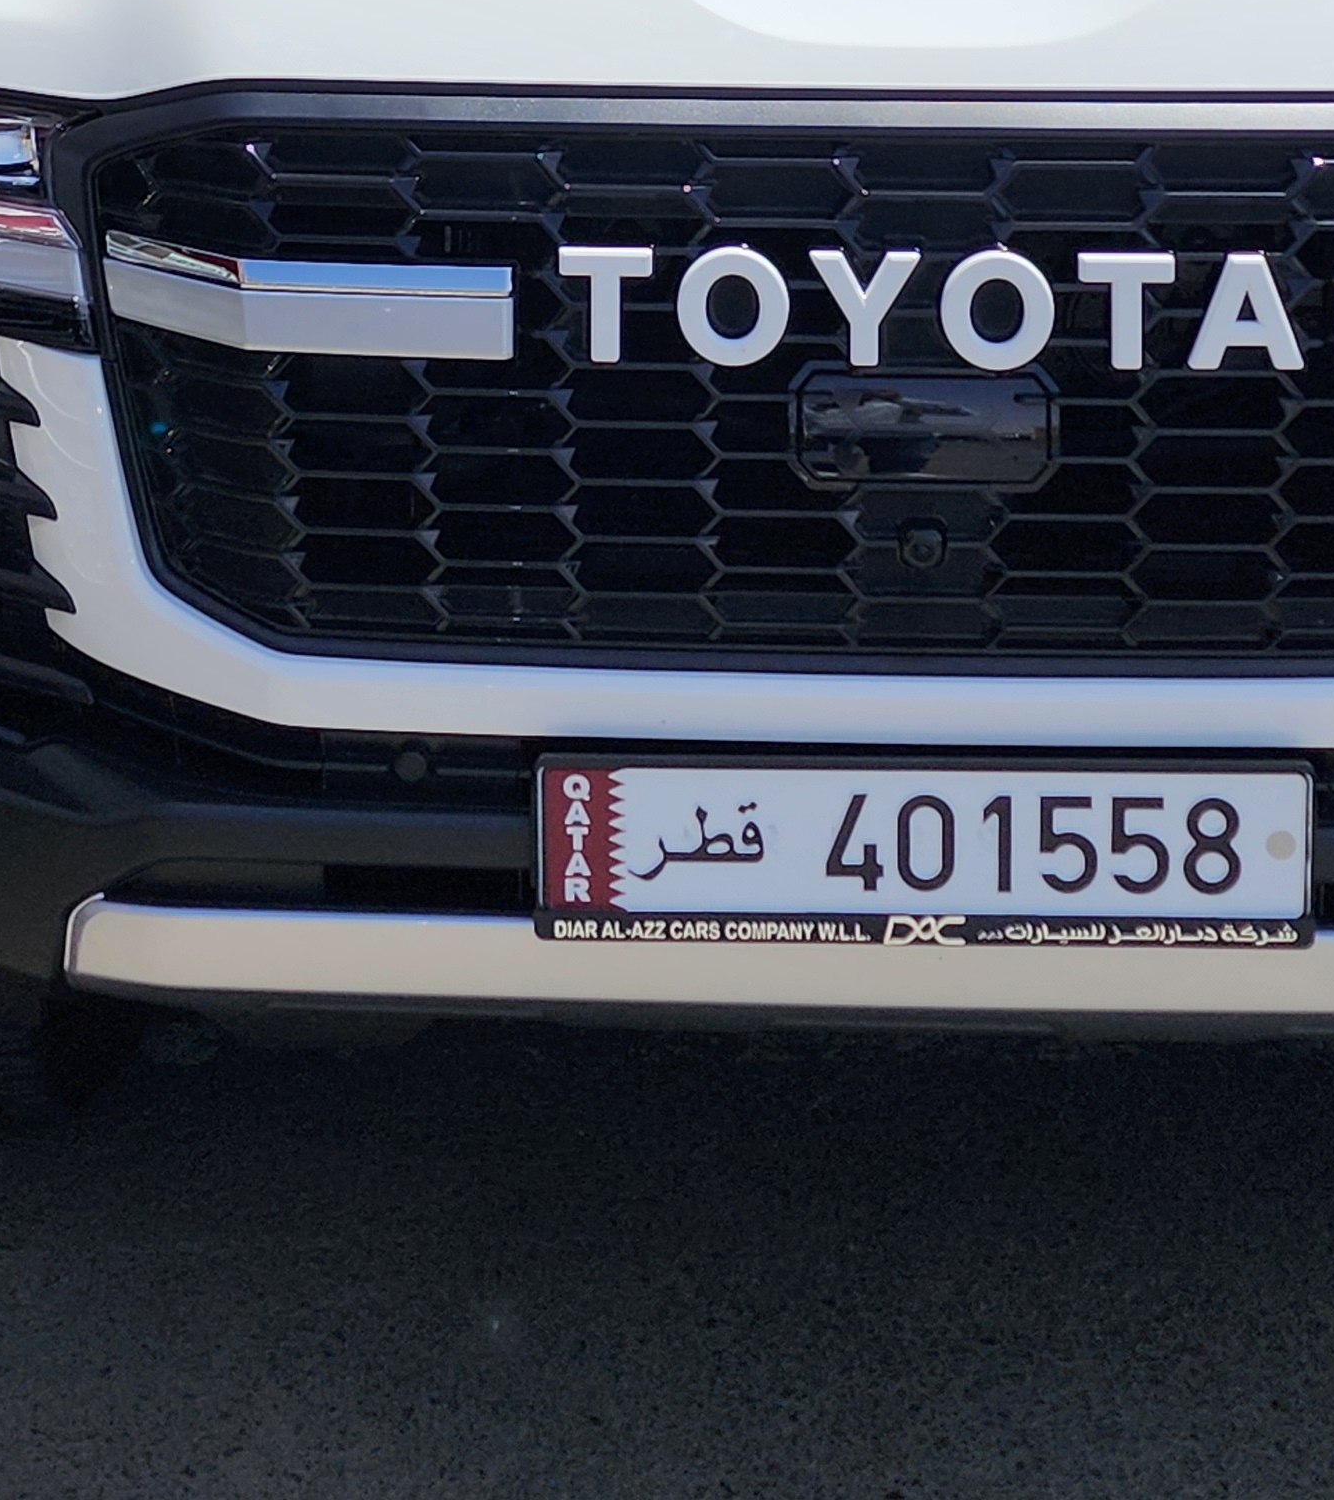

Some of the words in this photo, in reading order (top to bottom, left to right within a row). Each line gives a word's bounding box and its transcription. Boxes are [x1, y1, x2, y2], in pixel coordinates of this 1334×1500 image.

[558, 244, 1305, 371] TOYOTA
[562, 773, 592, 903] QATAR
[628, 801, 764, 881] قطر
[825, 793, 1242, 895] 401558
[553, 919, 597, 939] DIAR
[601, 919, 667, 940] AL-AZZ
[670, 920, 720, 940] CARS
[724, 921, 815, 941] COMPANY
[817, 922, 872, 942] W.L.L.
[1004, 921, 1107, 945] للسيارات
[1221, 921, 1298, 946] شركة
